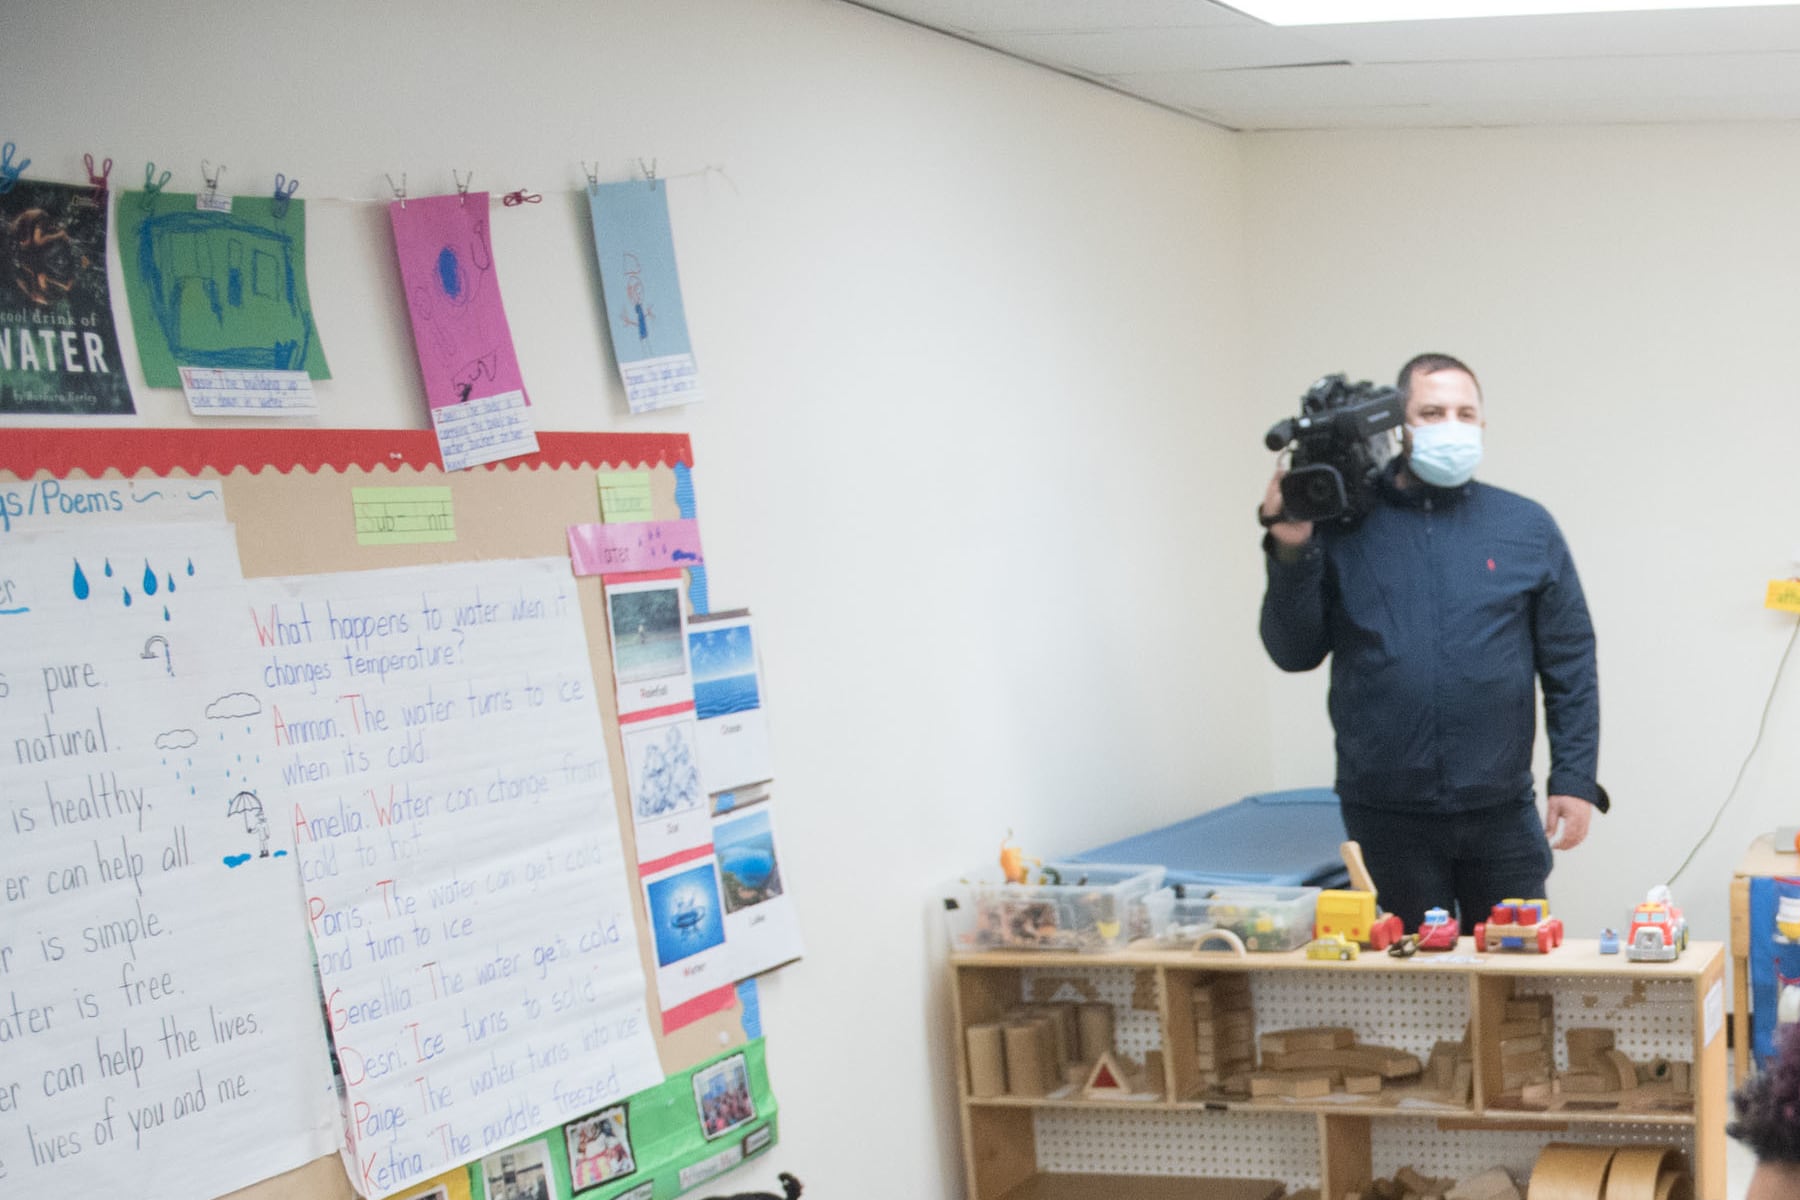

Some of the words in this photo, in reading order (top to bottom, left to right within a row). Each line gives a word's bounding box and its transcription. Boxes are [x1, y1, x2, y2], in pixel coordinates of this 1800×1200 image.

[32, 309, 77, 326] drink
[80, 312, 98, 327] of
[250, 601, 312, 647] What
[326, 599, 409, 651] happens
[422, 592, 442, 631] to
[454, 584, 499, 627] water
[264, 657, 332, 695] changes
[344, 627, 465, 686] temperature?
[403, 684, 453, 728] water
[466, 675, 512, 718] turns
[524, 668, 543, 706] to
[15, 706, 121, 765] natural.
[283, 757, 330, 786] when
[446, 788, 478, 814] can
[488, 768, 548, 804] change
[12, 807, 36, 834] is
[45, 771, 152, 832] healthy.
[48, 864, 88, 895] can
[94, 840, 143, 896] help
[302, 841, 338, 882] cold
[355, 835, 376, 867] to
[431, 875, 476, 910] water
[38, 931, 65, 962] is
[83, 899, 173, 961] simple.
[320, 947, 352, 976] and
[367, 932, 404, 963] turn
[412, 920, 431, 948] to
[73, 988, 99, 1020] is
[119, 961, 185, 1007] free.
[478, 952, 521, 986] water
[462, 1005, 508, 1045] turns
[522, 996, 541, 1021] to
[43, 1063, 84, 1097] can
[96, 1028, 144, 1088] help
[158, 1014, 200, 1060] the
[470, 1050, 519, 1097] water
[26, 1124, 82, 1168] lives
[94, 1096, 115, 1146] of
[128, 1101, 164, 1150] you
[174, 1070, 206, 1120] and
[483, 1104, 542, 1147] puddle
